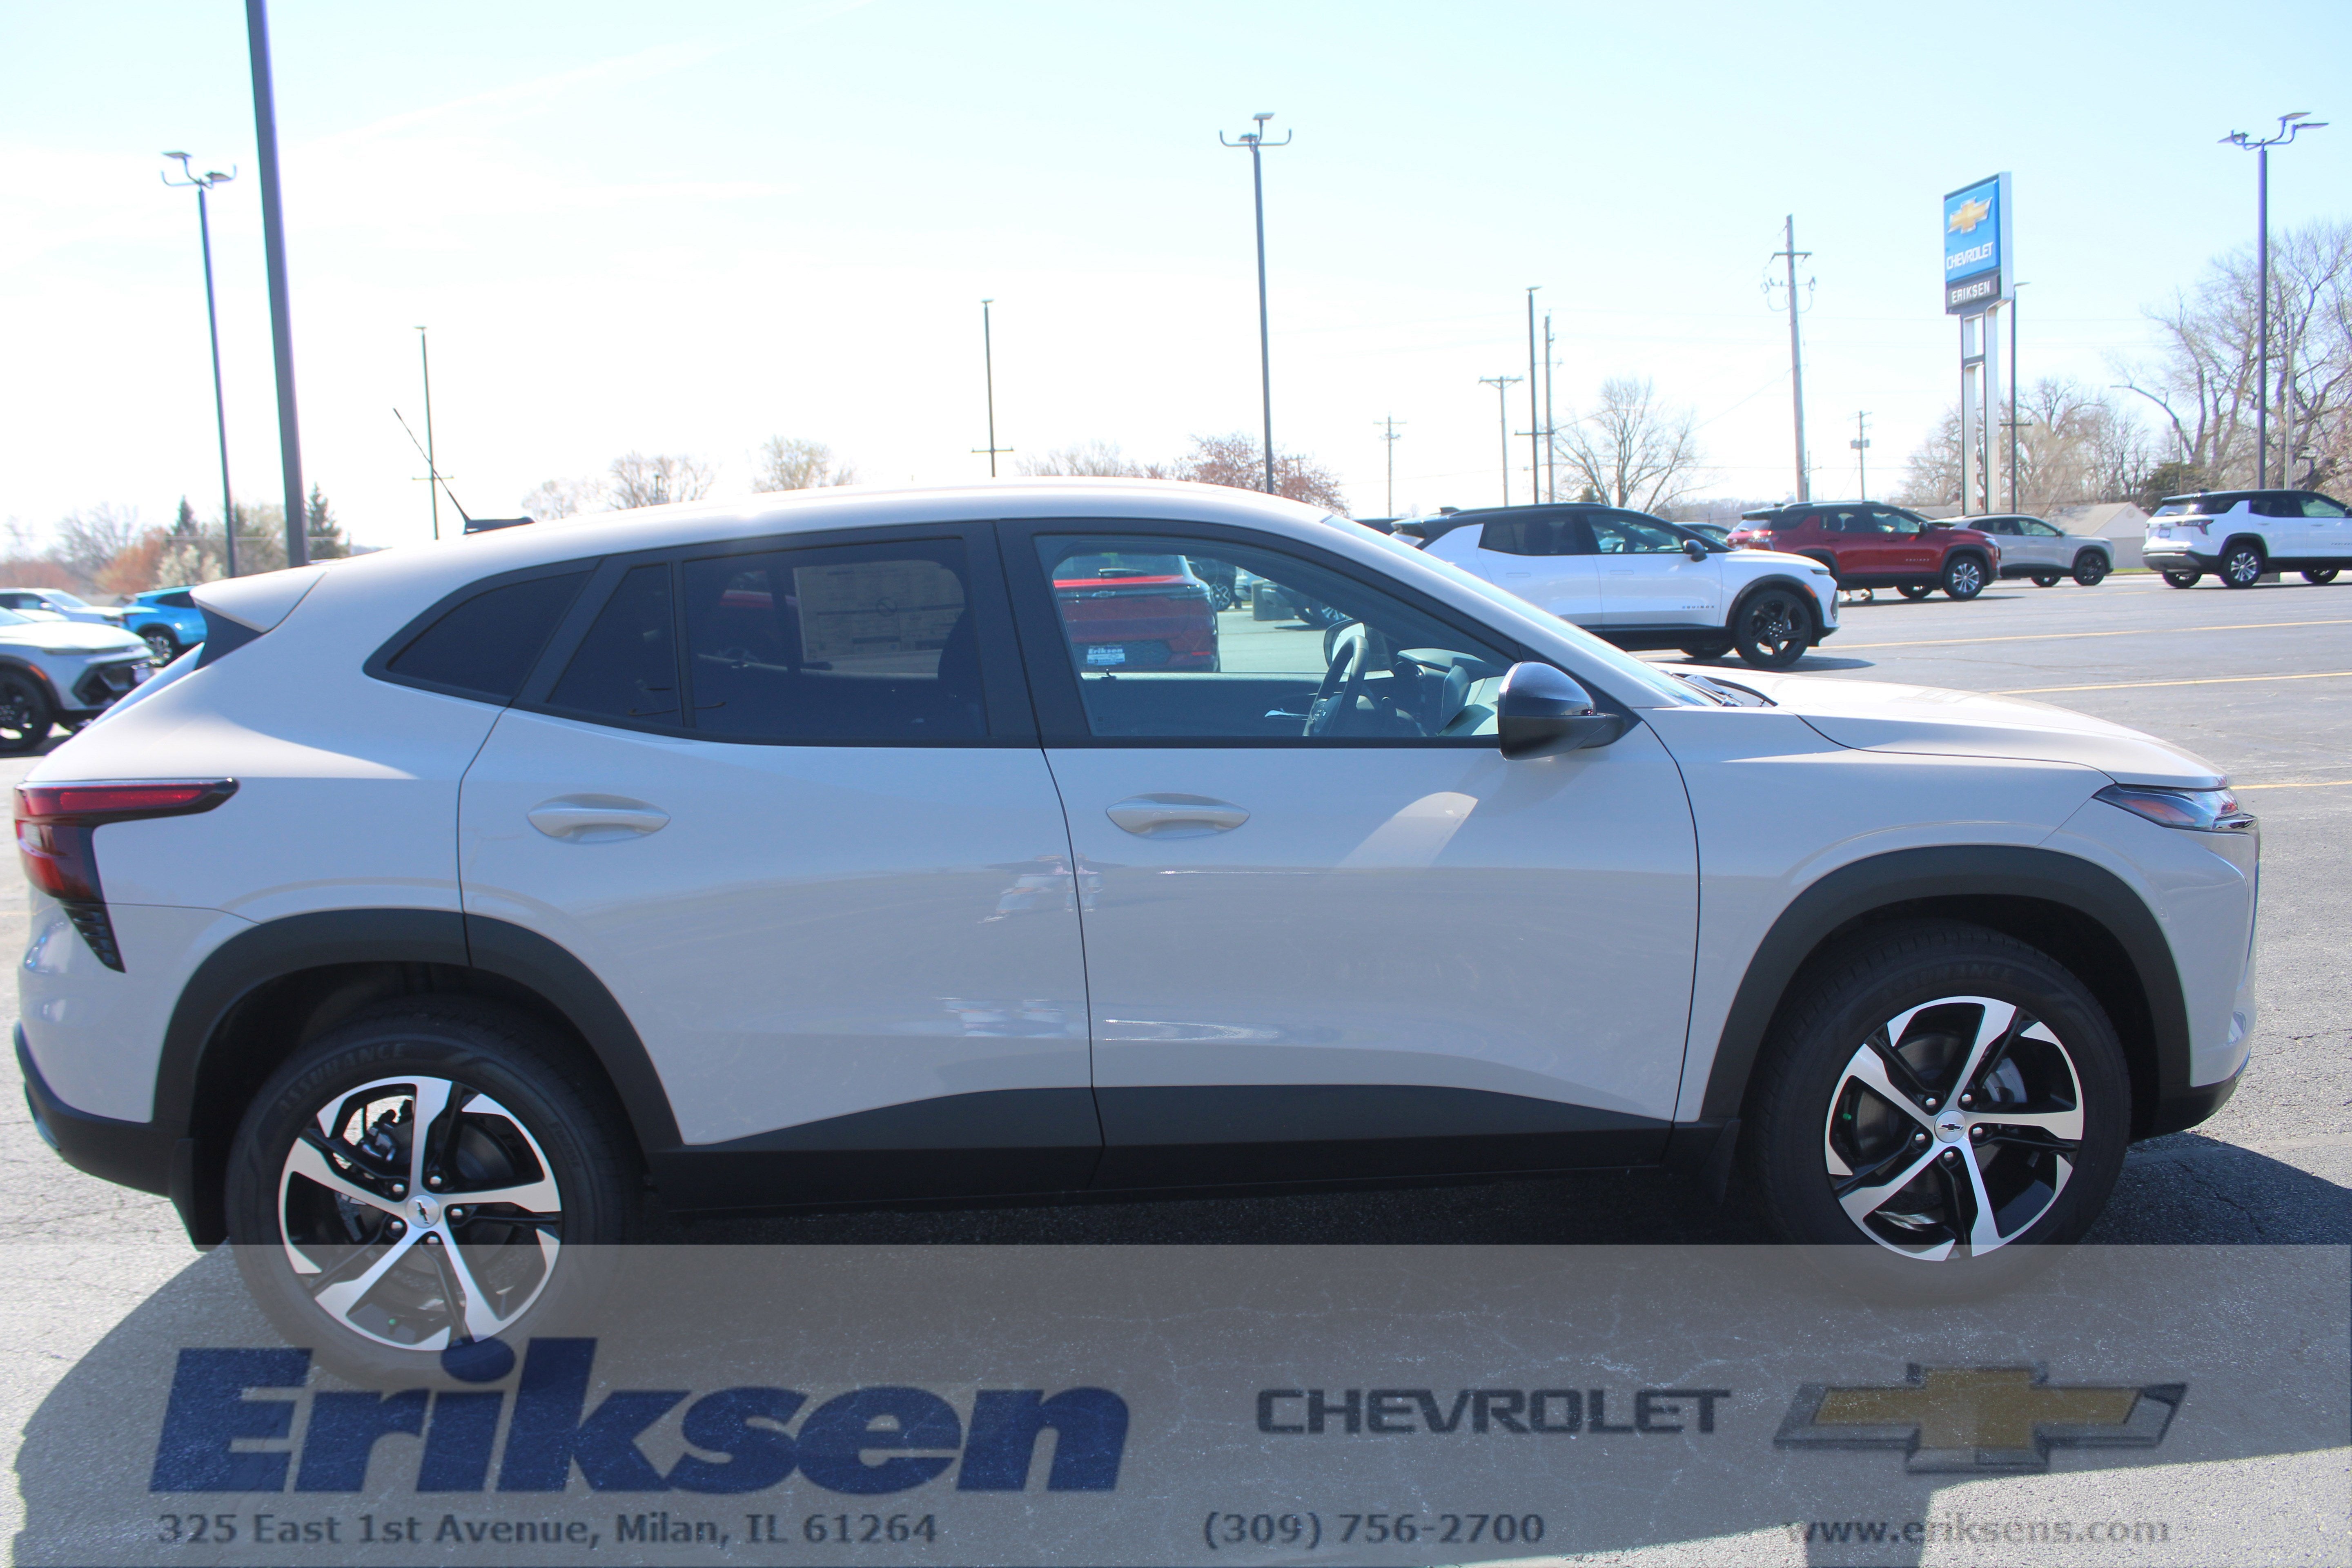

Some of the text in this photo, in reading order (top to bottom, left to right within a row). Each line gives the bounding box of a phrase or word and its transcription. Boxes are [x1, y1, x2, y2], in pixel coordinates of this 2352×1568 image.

[1947, 242, 1993, 270] CHEVROLET
[1952, 281, 1990, 303] ERIKSEN
[278, 1042, 406, 1114] ASSURANCE
